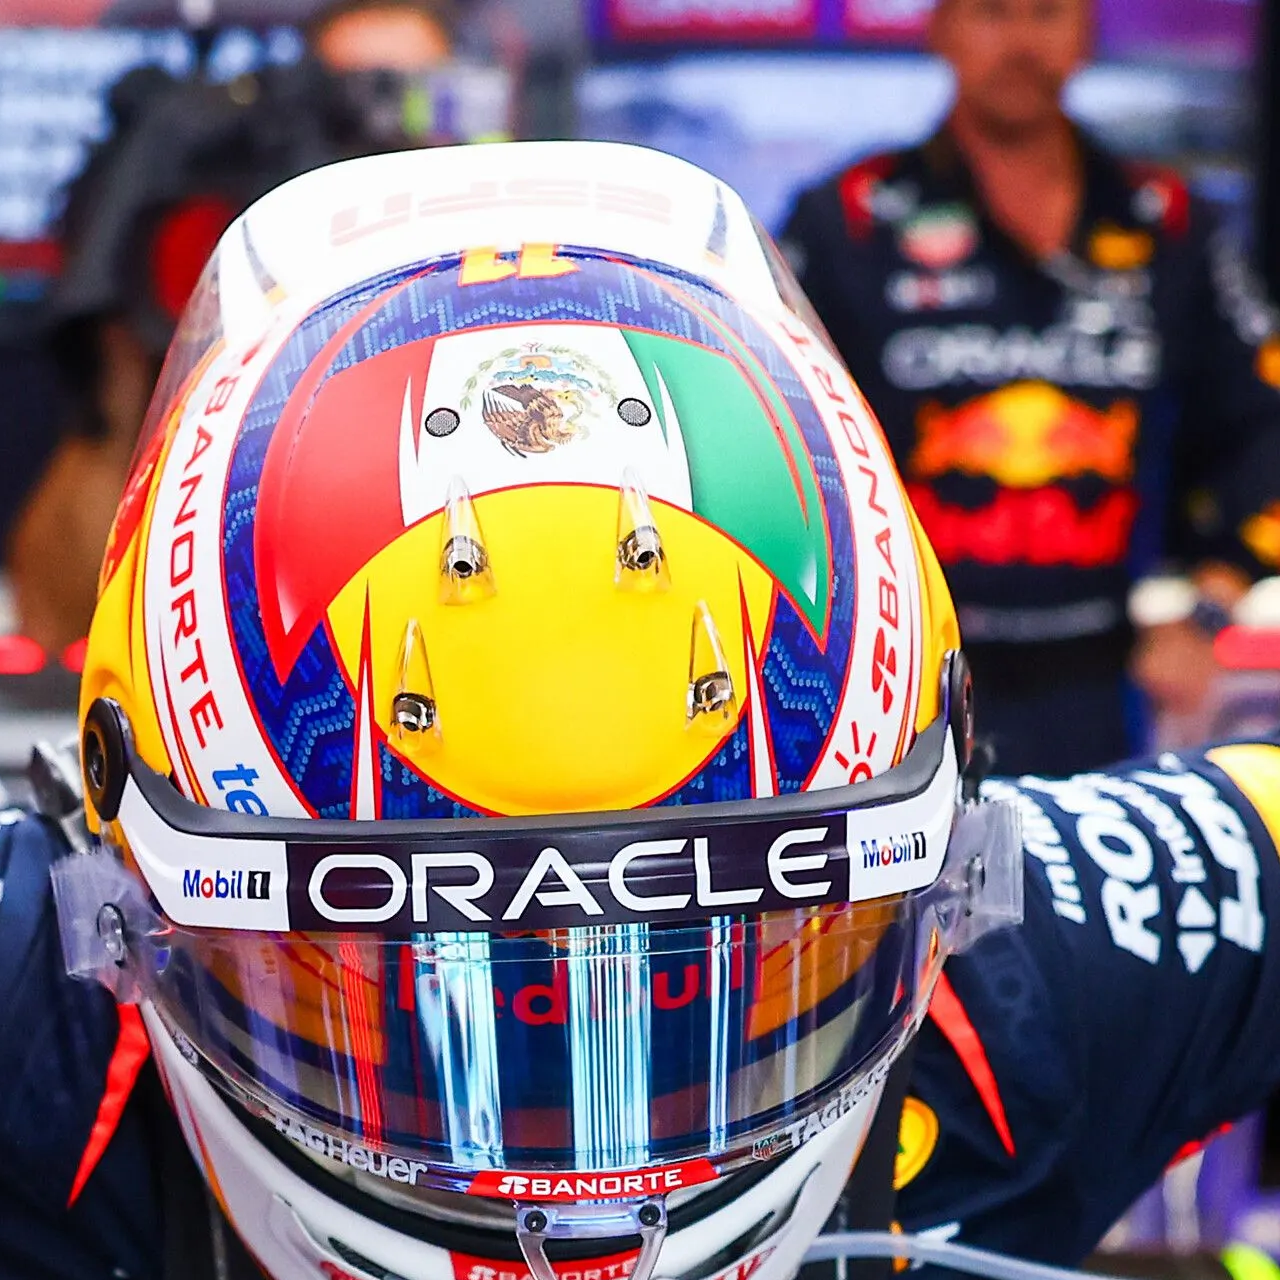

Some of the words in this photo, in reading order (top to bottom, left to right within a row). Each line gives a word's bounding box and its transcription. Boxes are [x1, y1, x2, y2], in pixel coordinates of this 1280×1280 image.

[779, 320, 901, 628] BANORT
[170, 371, 237, 750] BANORTE
[211, 762, 269, 818] te
[308, 826, 832, 923] ORACLE
[861, 833, 910, 868] Mobil
[182, 868, 244, 900] Mobil
[530, 1168, 683, 1198] BANORTE
